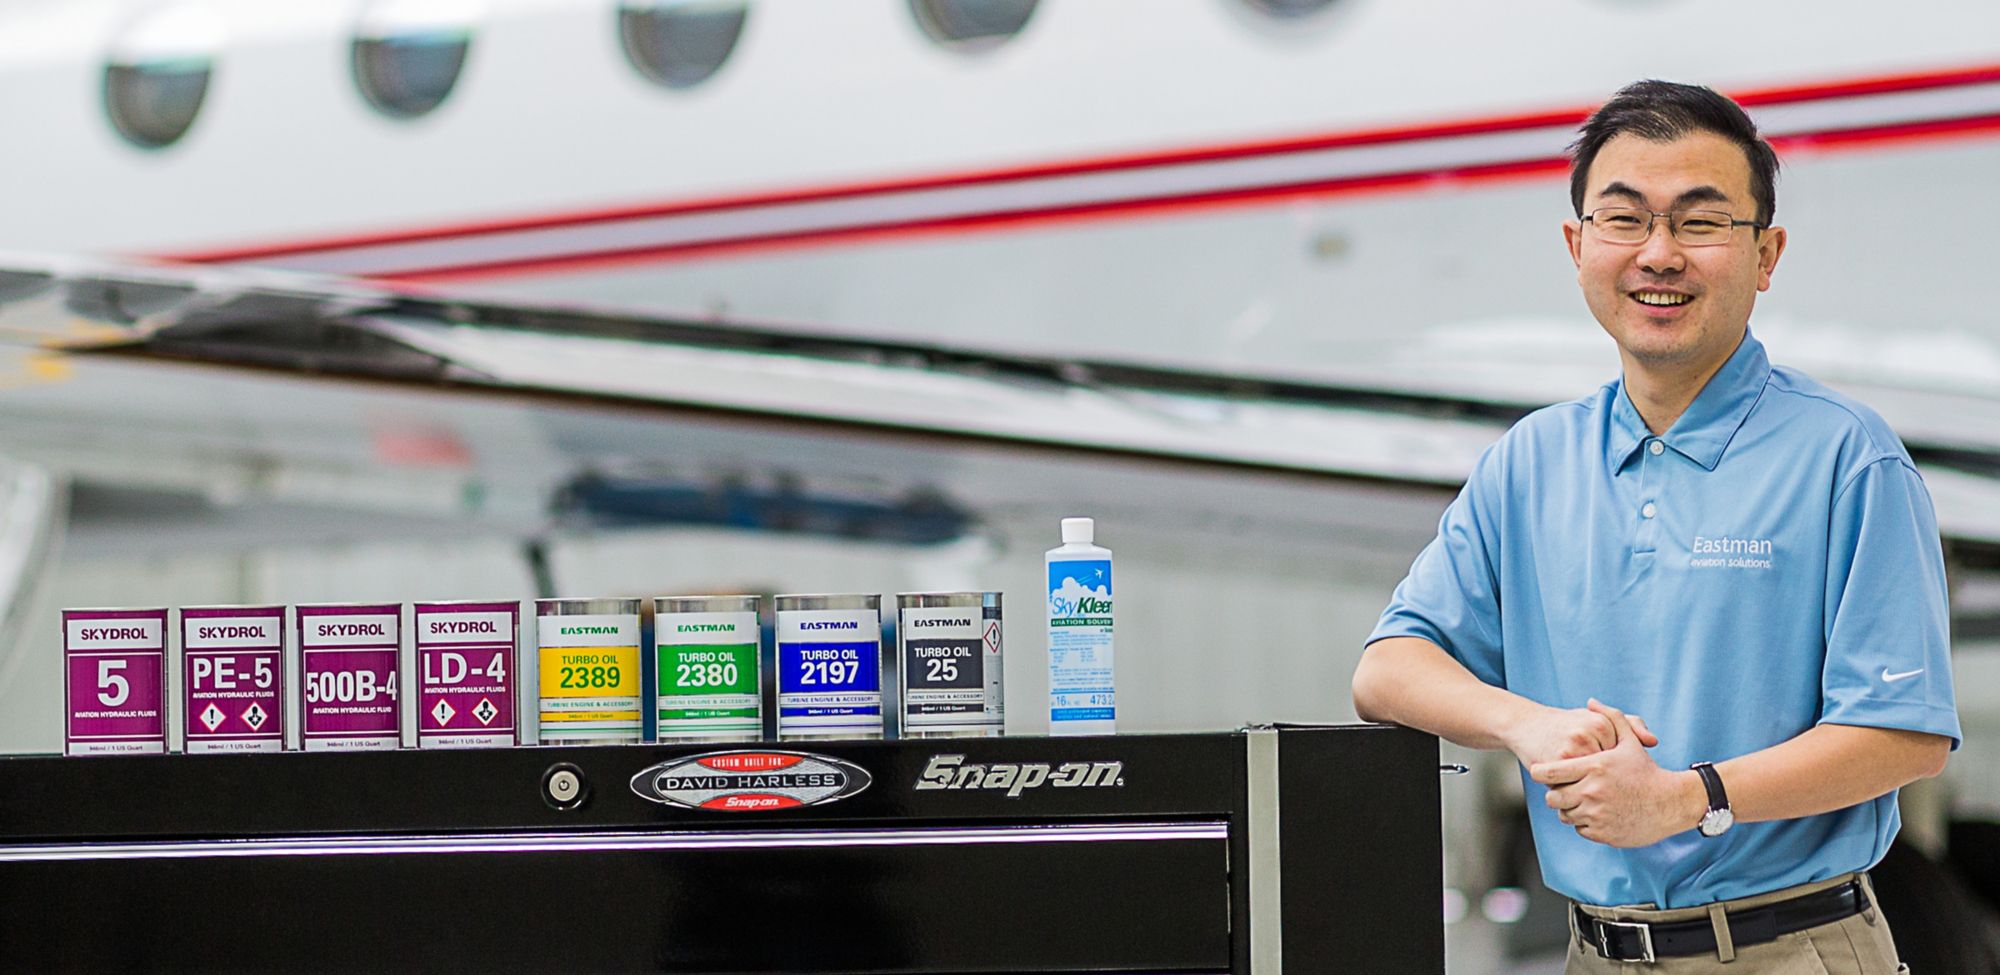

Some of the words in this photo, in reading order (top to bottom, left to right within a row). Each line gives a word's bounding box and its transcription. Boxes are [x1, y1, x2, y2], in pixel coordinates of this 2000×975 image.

[1692, 536, 1773, 555] Eastman
[1690, 558, 1726, 568] aviation
[1727, 557, 1772, 569] solutions
[318, 623, 385, 636] SKYDROL
[430, 621, 497, 634] SKYDROL
[677, 624, 736, 632] EASTMAN
[800, 621, 858, 630] EASTMAN
[914, 619, 972, 627] EASTMAN
[81, 627, 148, 640] SKYDROL
[199, 626, 266, 639] SKYDROL
[561, 626, 619, 635] EASTMAN
[678, 652, 715, 663] TURBO
[718, 652, 736, 662] OIL
[800, 649, 838, 660] TURBO
[841, 649, 859, 660] OIL
[914, 647, 950, 658] TURBO
[953, 647, 972, 657] OIL
[561, 655, 599, 665] TURBO
[602, 654, 619, 664] OIL
[193, 657, 273, 689] PE-5
[424, 652, 506, 684] LD-4
[800, 661, 859, 684] 2197
[926, 658, 958, 681] 25
[560, 666, 621, 688] 2389
[676, 663, 737, 687] 2380
[97, 659, 130, 707] 5
[306, 670, 398, 703] 500B-4
[712, 758, 739, 767] CUSTOM
[744, 757, 764, 766] BUILT
[666, 777, 728, 790] DAVID
[738, 774, 836, 788] HARLESS
